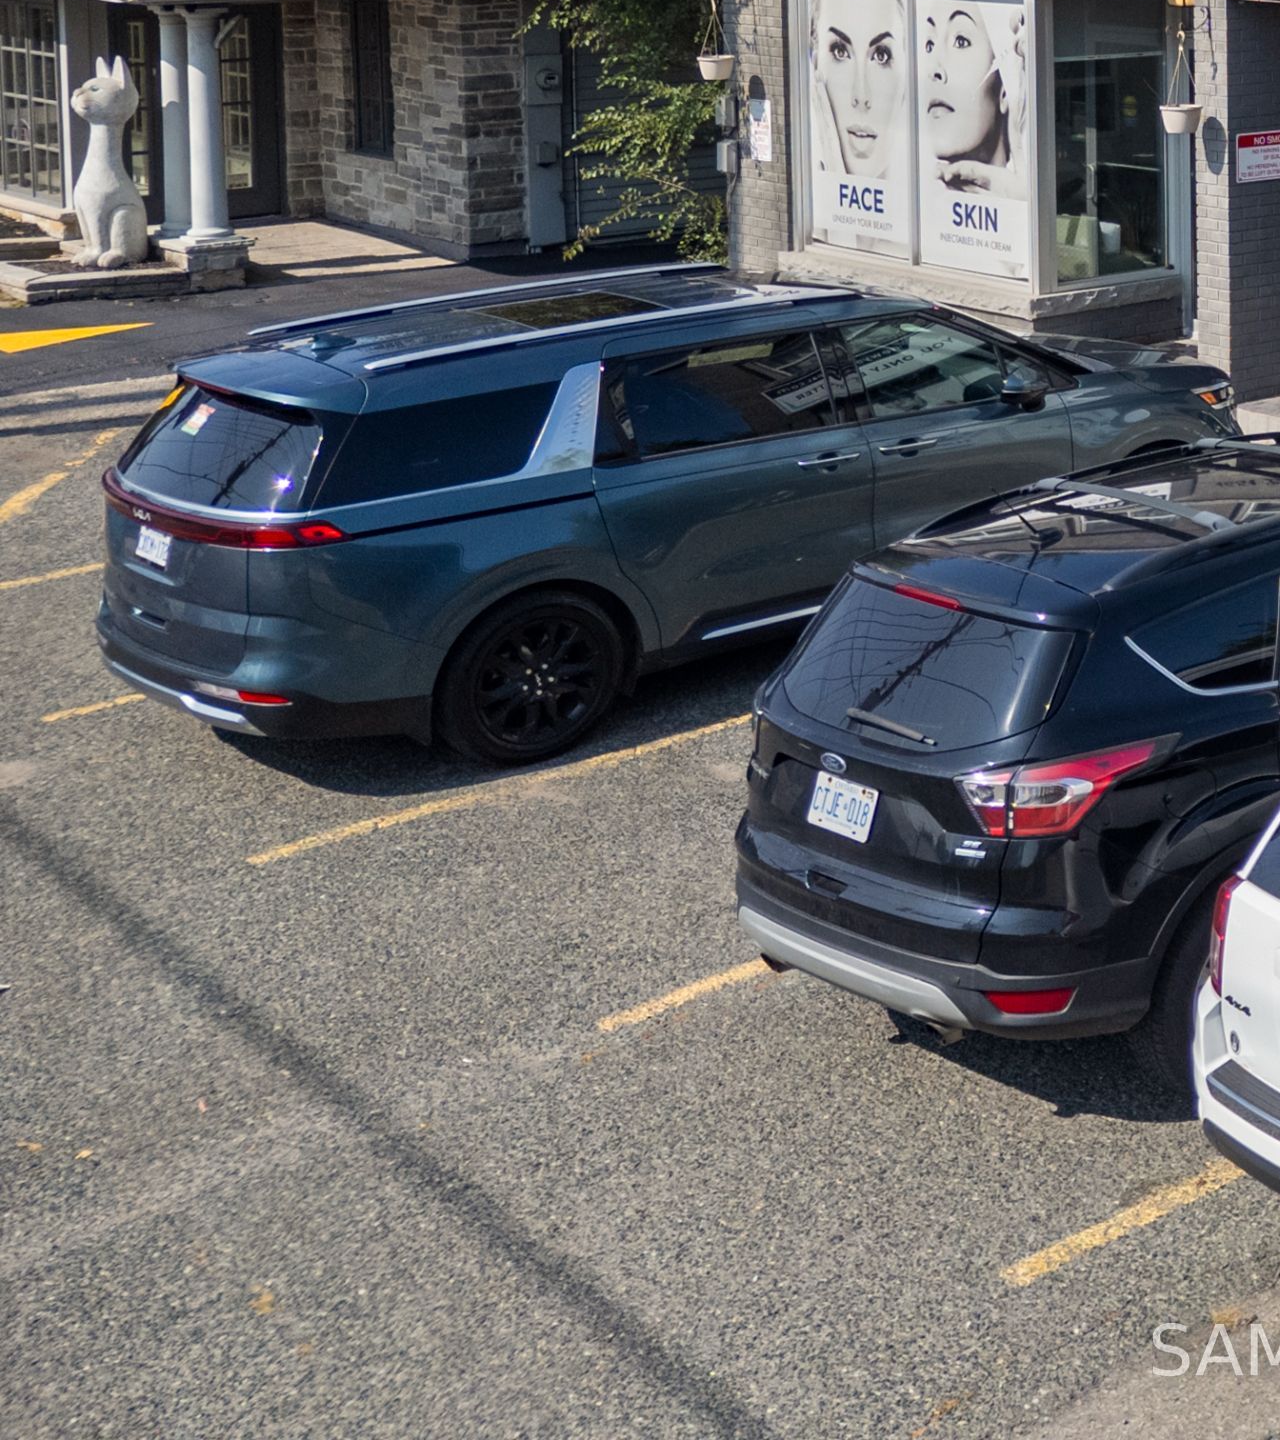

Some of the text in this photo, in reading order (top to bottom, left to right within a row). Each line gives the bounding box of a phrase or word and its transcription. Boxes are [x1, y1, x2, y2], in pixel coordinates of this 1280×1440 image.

[1253, 136, 1265, 145] NO
[839, 184, 884, 213] FACE
[857, 217, 872, 228] YOUR
[873, 220, 893, 231] BEAUTY
[952, 202, 998, 233] SKIN
[975, 239, 983, 248] IN
[984, 240, 989, 249] A
[990, 241, 1012, 253] CREAM
